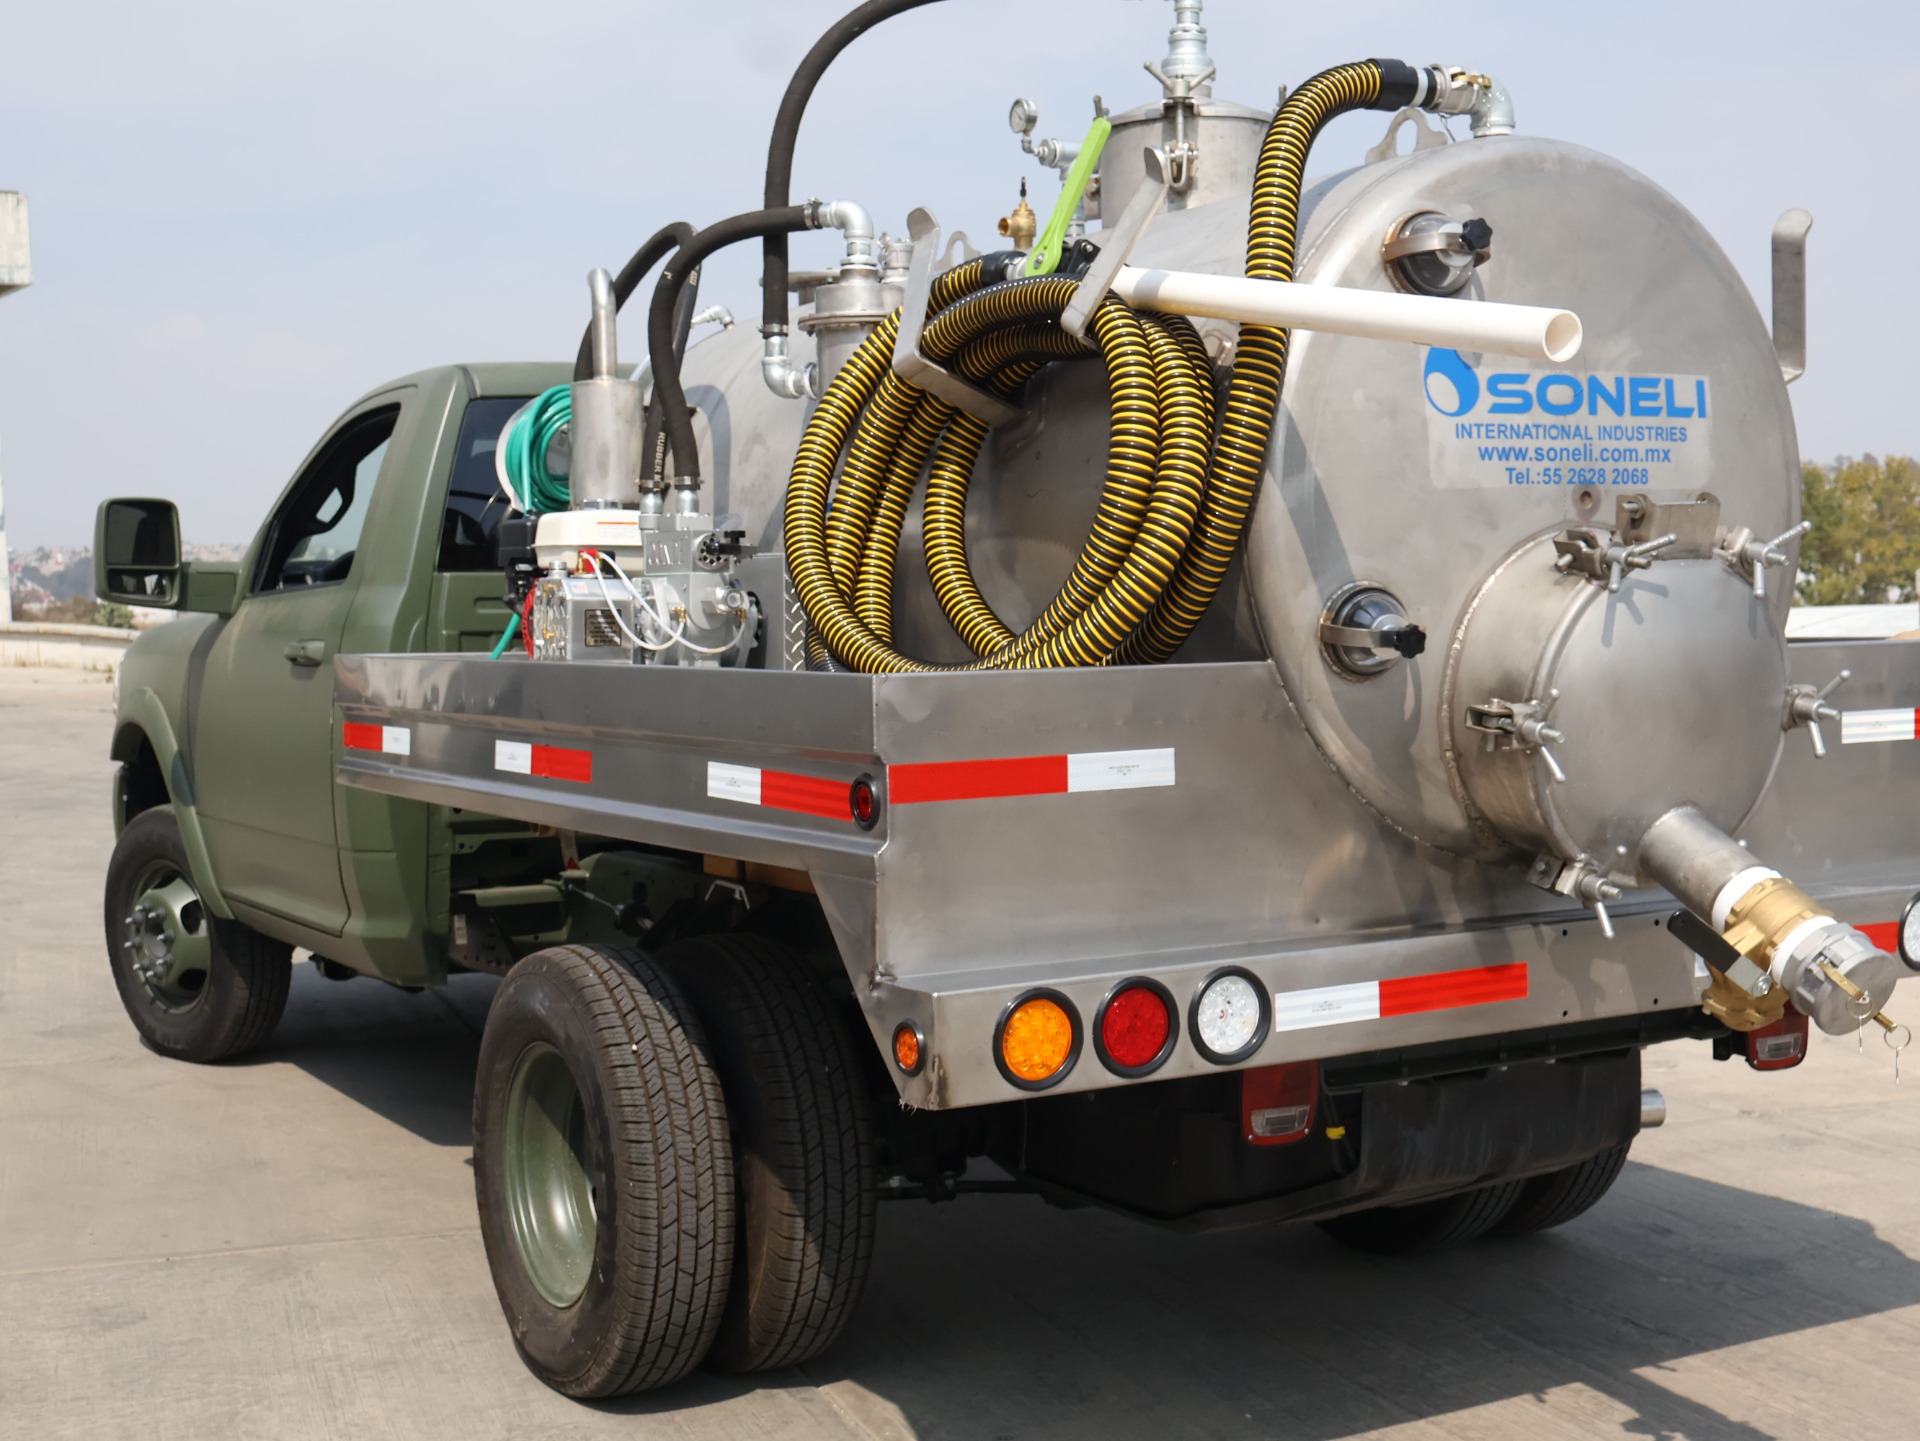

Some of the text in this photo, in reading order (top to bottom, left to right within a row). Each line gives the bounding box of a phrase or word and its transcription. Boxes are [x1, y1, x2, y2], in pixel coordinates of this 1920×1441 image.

[1486, 373, 1707, 419] SONELI
[1455, 423, 1688, 442] INTERNATIONAL INDUSTRIES
[654, 431, 666, 473] RUBBER
[1478, 443, 1671, 463] www.soneli.com.mx
[1567, 467, 1606, 485] 2628
[1612, 467, 1649, 485] 2068
